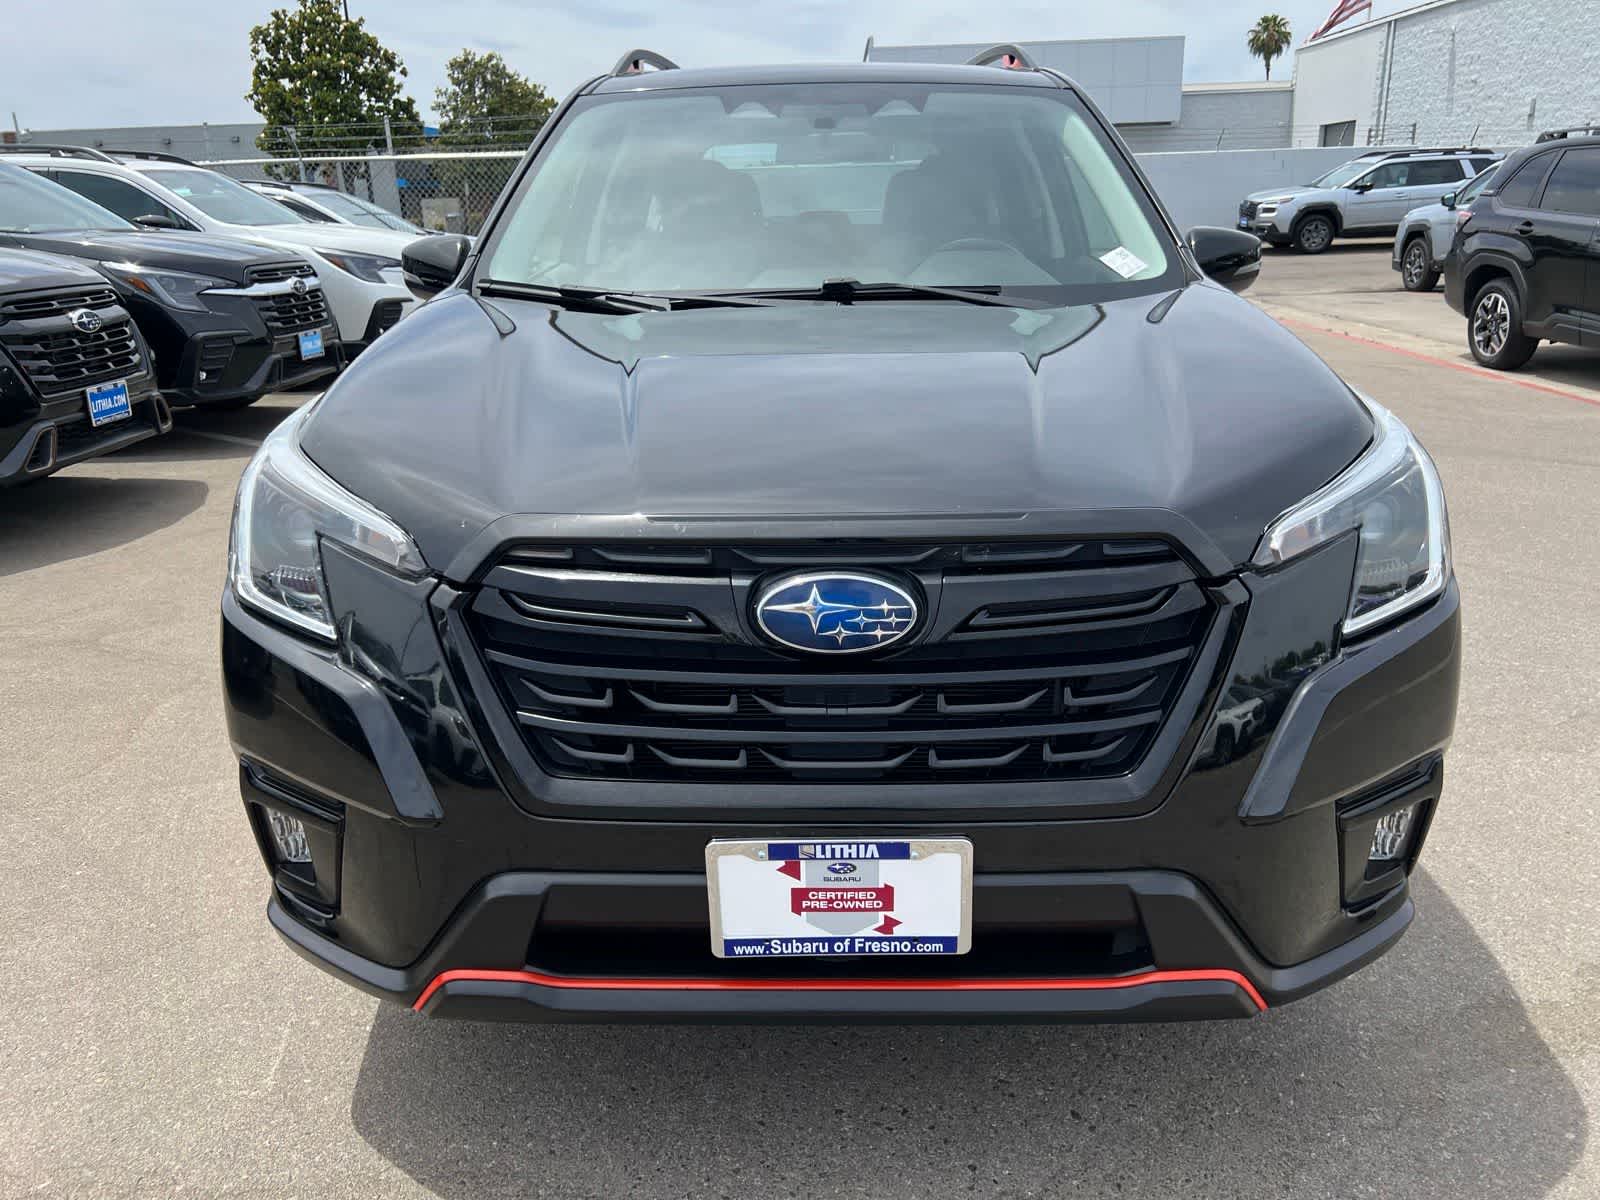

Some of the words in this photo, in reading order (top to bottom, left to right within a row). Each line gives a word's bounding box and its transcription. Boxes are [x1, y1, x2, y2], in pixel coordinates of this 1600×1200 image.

[91, 393, 127, 413] LITHIA.COM
[815, 844, 880, 859] LITHIA
[808, 891, 877, 900] CERTIFIED
[801, 900, 883, 909] PRE-OWNED
[833, 938, 851, 953] of
